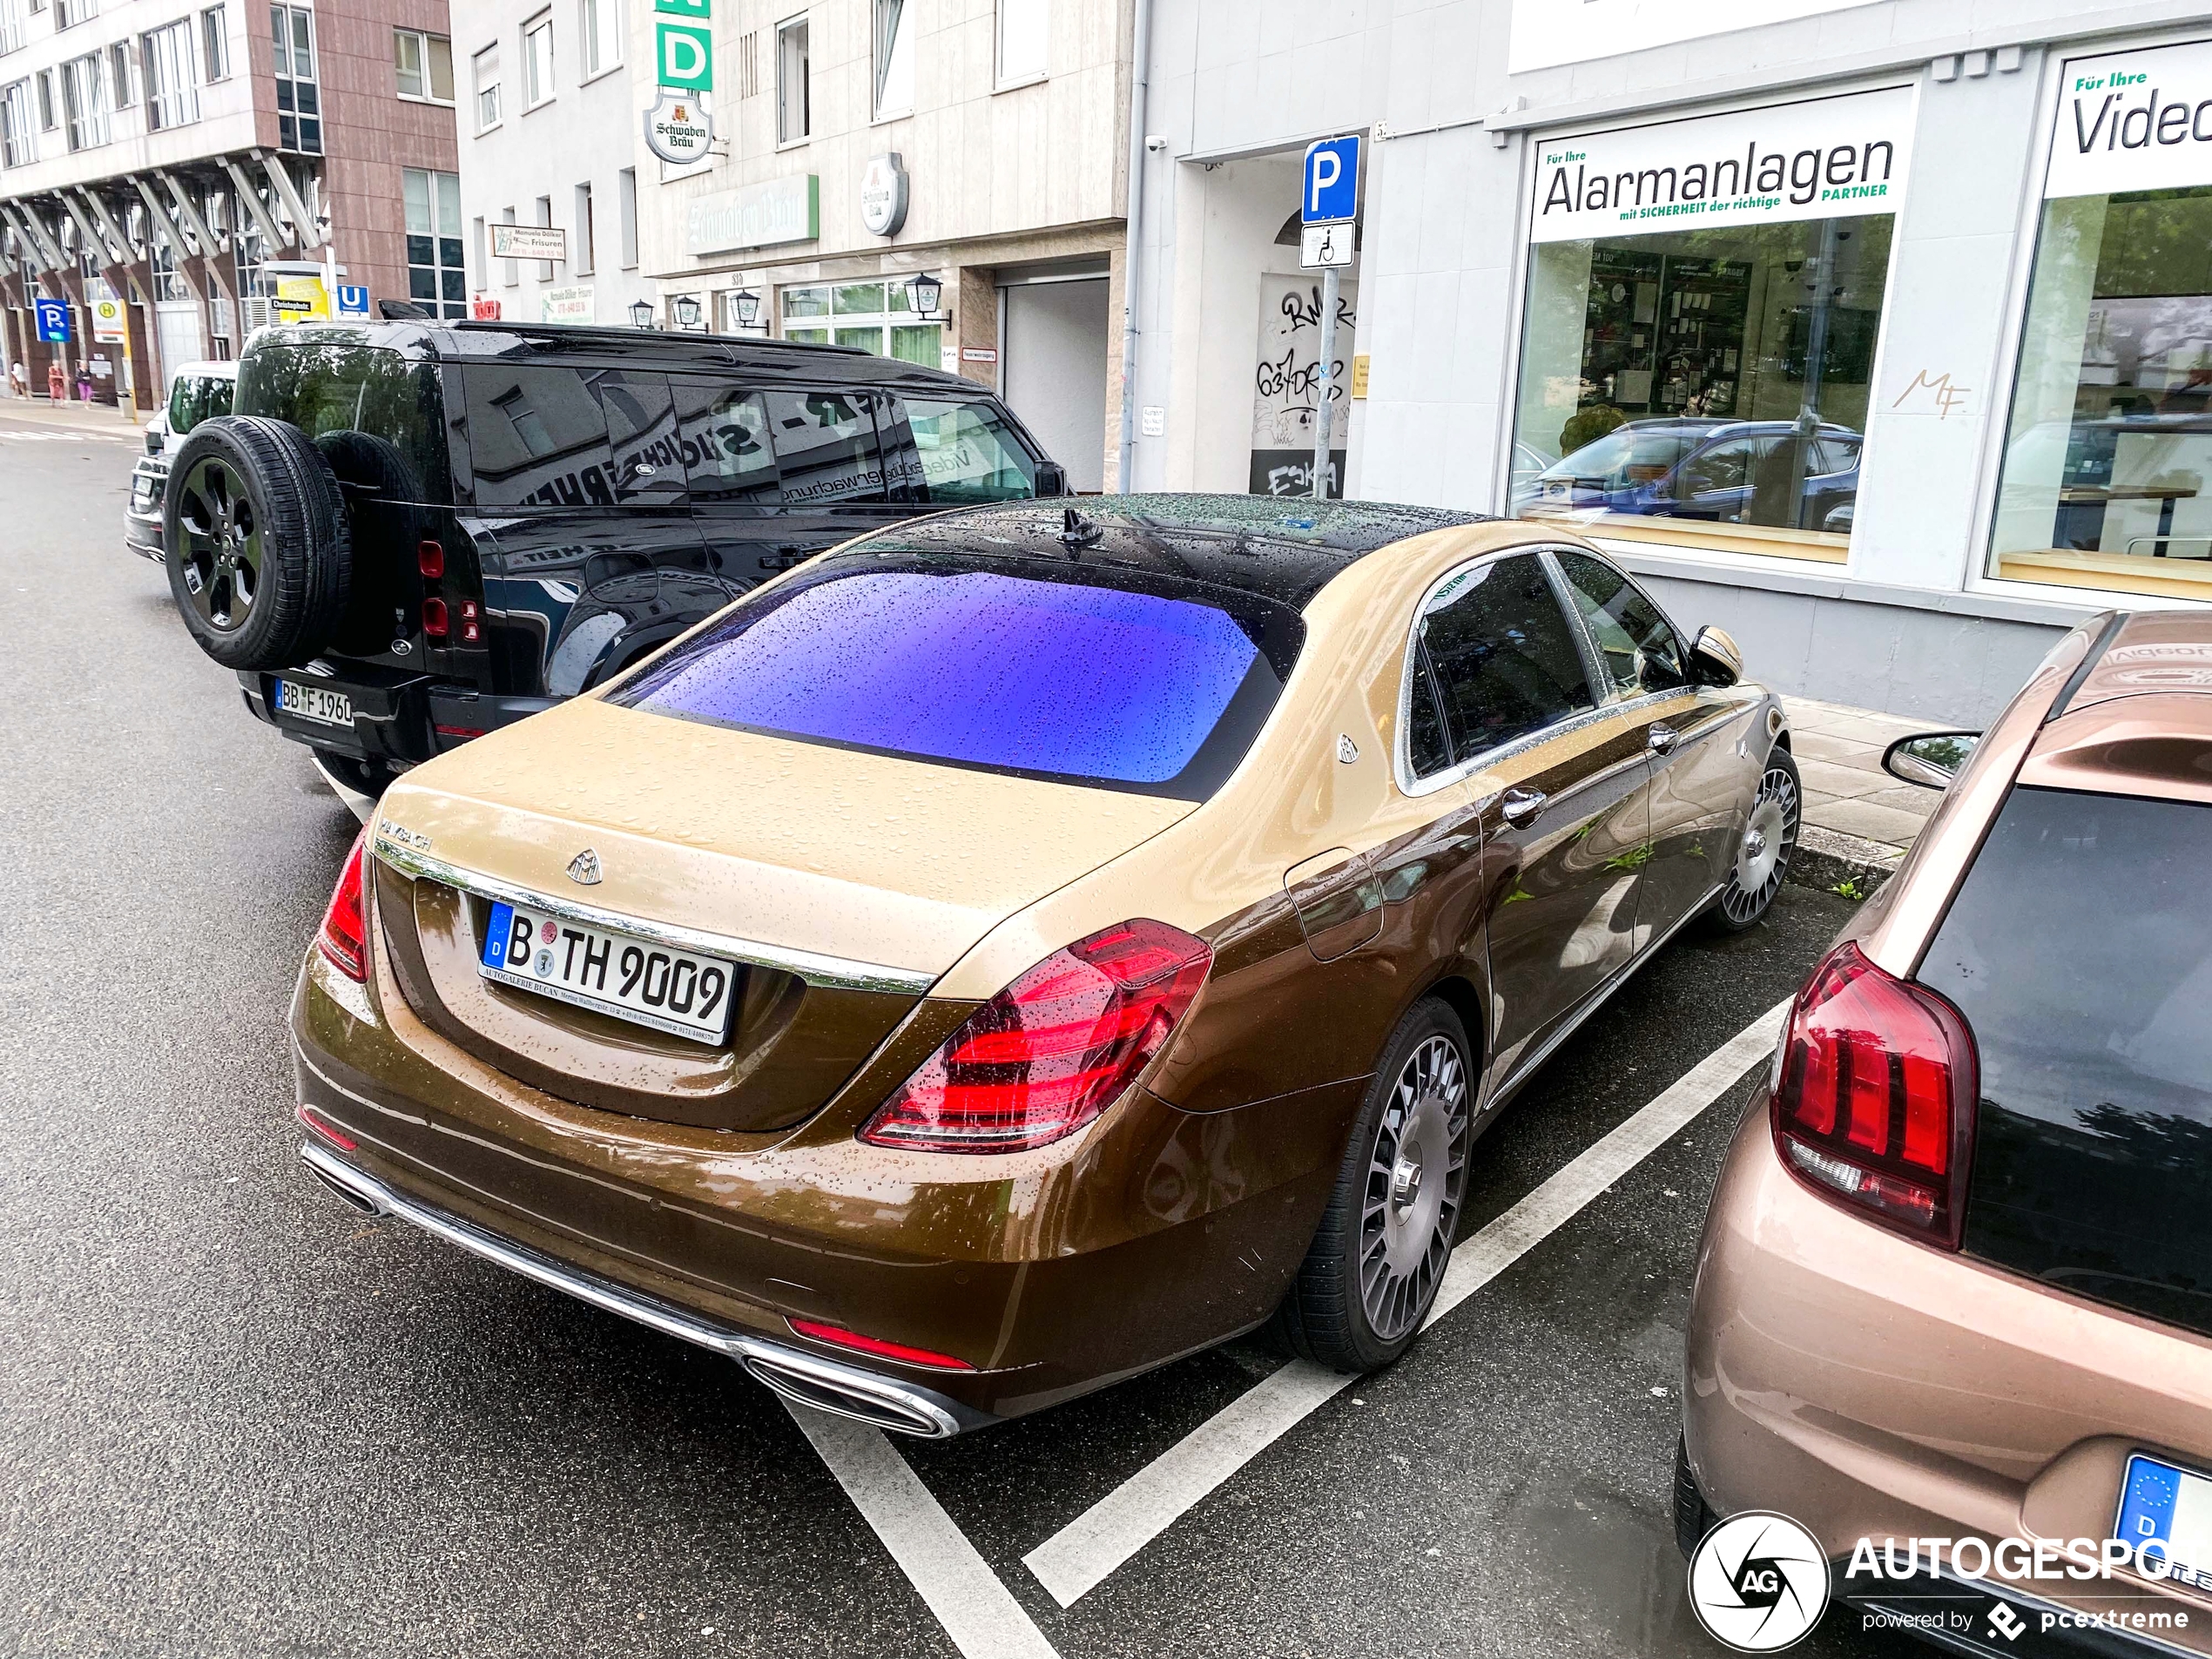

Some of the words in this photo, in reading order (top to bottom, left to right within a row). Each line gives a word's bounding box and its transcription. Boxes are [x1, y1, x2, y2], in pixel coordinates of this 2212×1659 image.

[664, 30, 706, 79] D
[2075, 76, 2104, 91] Für
[2109, 71, 2148, 87] Ihre
[656, 123, 706, 138] Schwaben
[669, 136, 694, 148] Bräu
[1547, 153, 1563, 165] Für
[1565, 151, 1587, 162] Ihre
[1311, 150, 1342, 212] P
[1543, 140, 1893, 215] Alarmanlagen
[1620, 208, 1637, 220] mit
[1640, 202, 1707, 219] SICHERHEIT
[1710, 199, 1731, 212] der
[1732, 196, 1781, 212] richtige
[1821, 184, 1888, 201] PARTNER
[688, 196, 758, 245] Schwaben
[531, 239, 563, 247] Frisuren
[341, 286, 361, 307] U
[45, 309, 61, 328] P
[283, 683, 299, 709] BB
[307, 690, 315, 712] F
[319, 692, 353, 722] 1960
[491, 941, 501, 956] D
[507, 914, 533, 967] B
[562, 928, 611, 991] TH
[618, 946, 725, 1020] 9009
[484, 968, 533, 991] AUTOGALERIE
[534, 983, 558, 996] BUCAN
[2138, 1514, 2156, 1537] D
